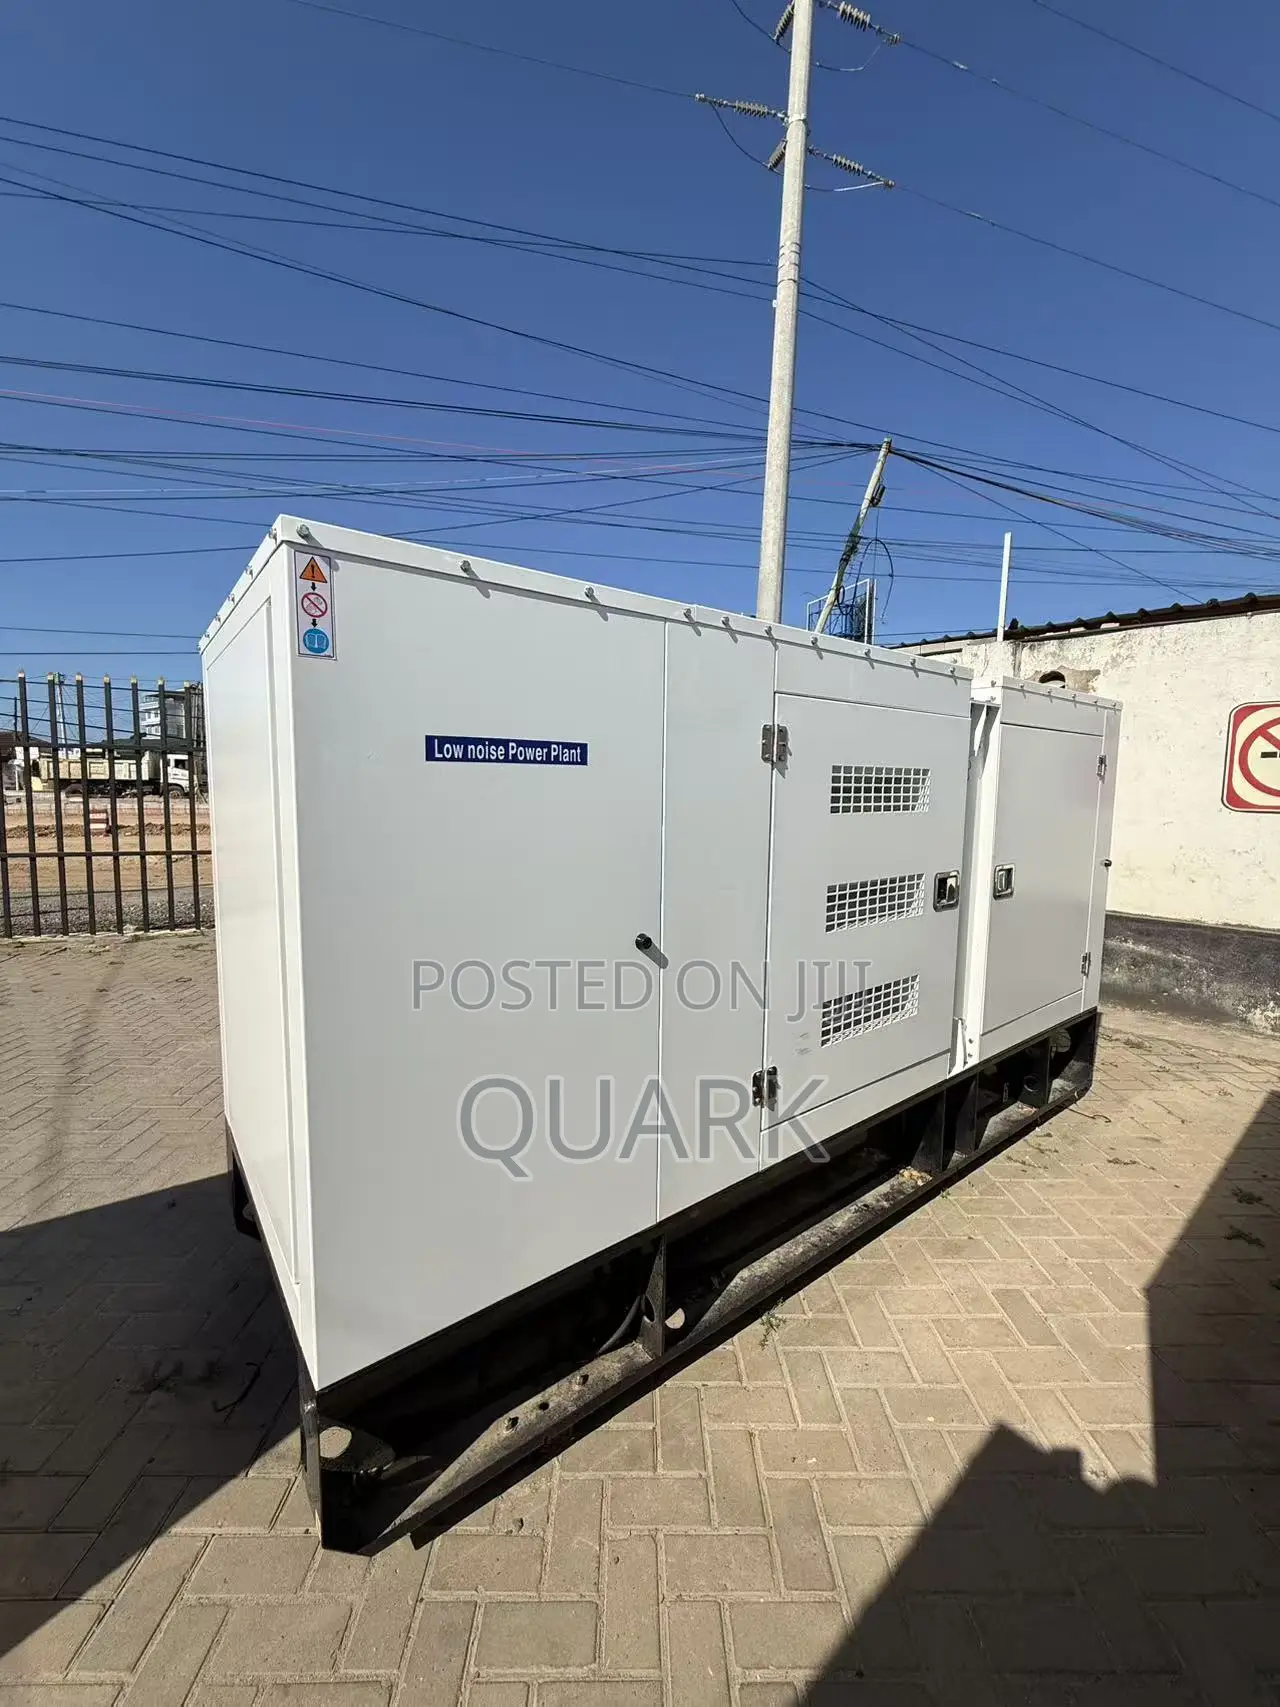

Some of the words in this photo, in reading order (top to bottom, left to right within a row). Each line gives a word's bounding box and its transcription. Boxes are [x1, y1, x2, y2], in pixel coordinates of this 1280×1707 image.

[434, 738, 464, 759] Low
[467, 741, 506, 761] noise
[508, 742, 548, 762] Power
[551, 744, 581, 763] Plant
